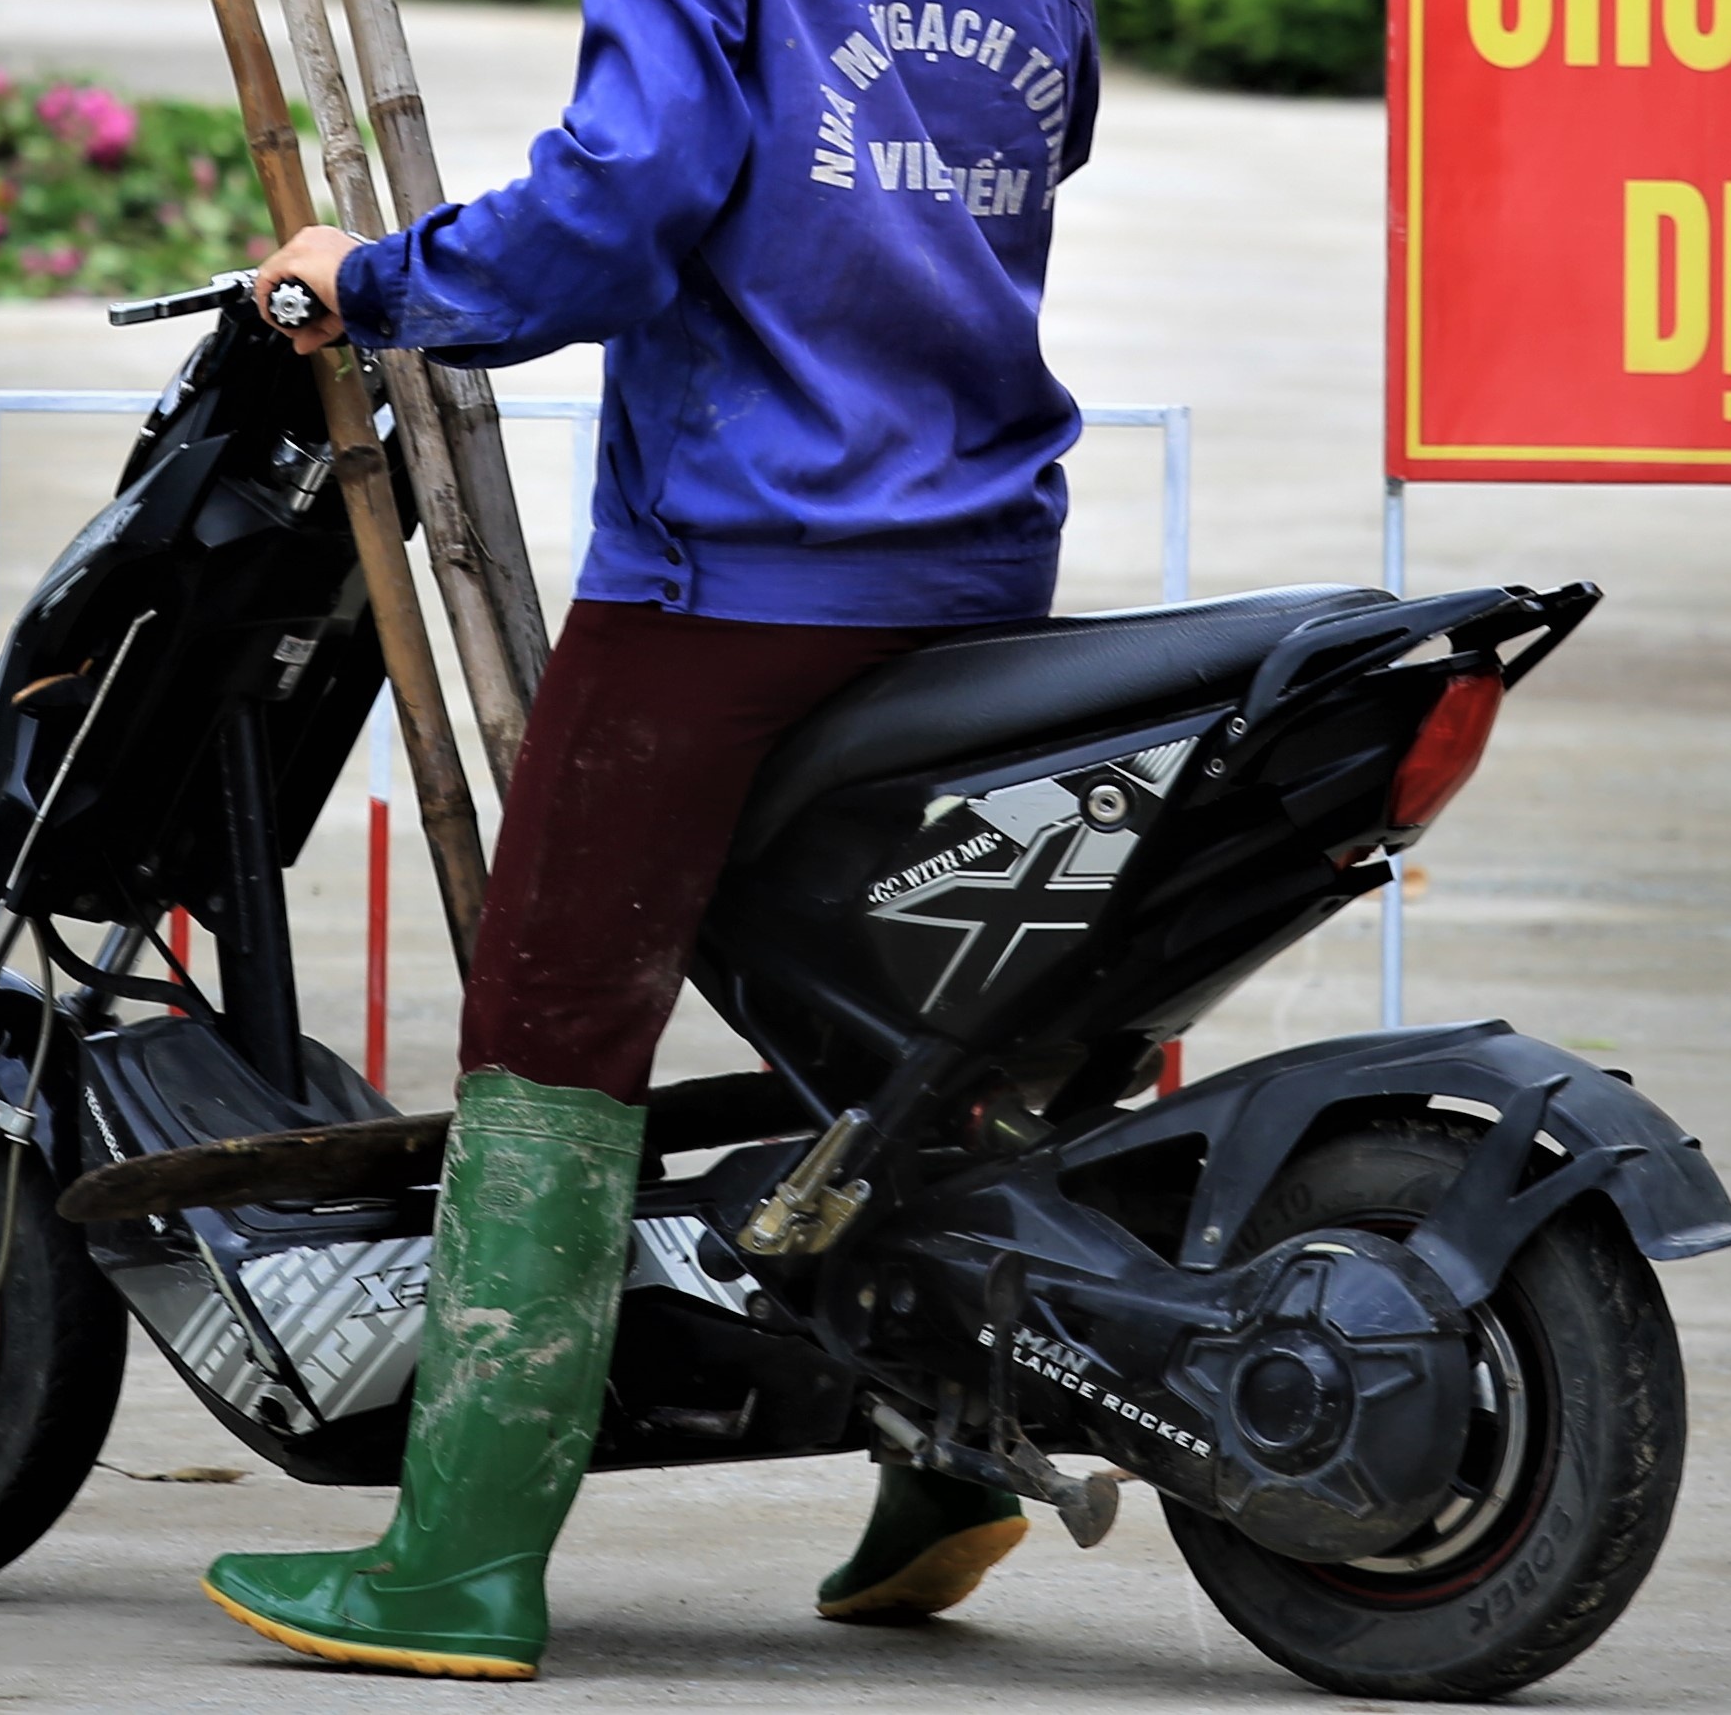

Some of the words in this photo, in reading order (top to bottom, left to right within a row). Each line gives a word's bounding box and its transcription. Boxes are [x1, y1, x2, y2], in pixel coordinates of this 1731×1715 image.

[885, 2, 1017, 73] GẠCH
[900, 849, 961, 887] WITH
[957, 832, 998, 863] ME
[977, 1329, 1099, 1400] BLANCE
[1101, 1393, 1212, 1459] ROCKER
